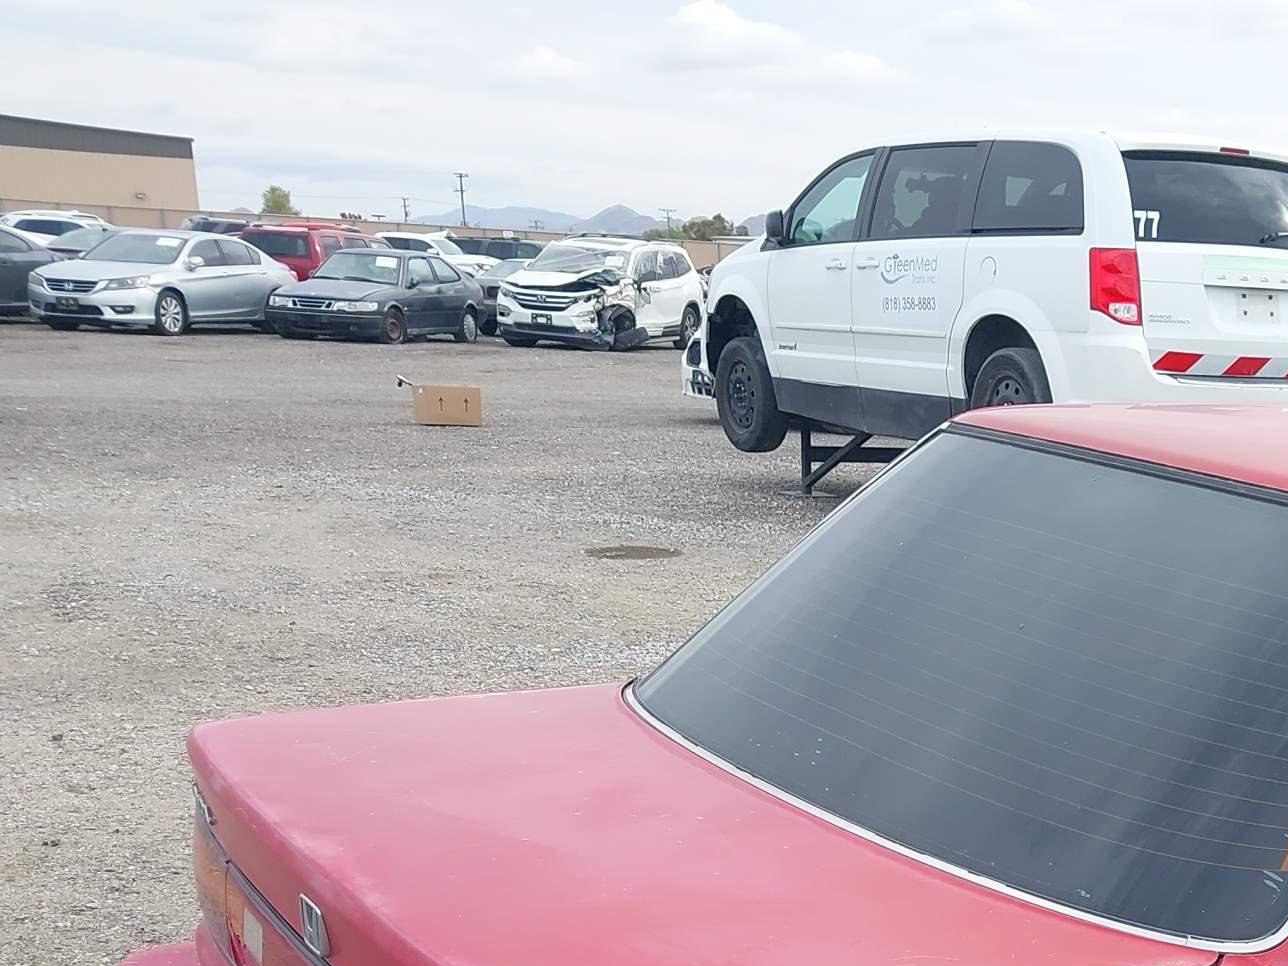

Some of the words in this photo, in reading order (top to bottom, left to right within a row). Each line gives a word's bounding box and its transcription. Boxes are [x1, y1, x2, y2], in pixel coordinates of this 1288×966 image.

[1134, 210, 1160, 238] 77
[884, 254, 937, 273] GreenMed
[882, 296, 900, 312] (818)
[902, 296, 936, 311] 358-8883
